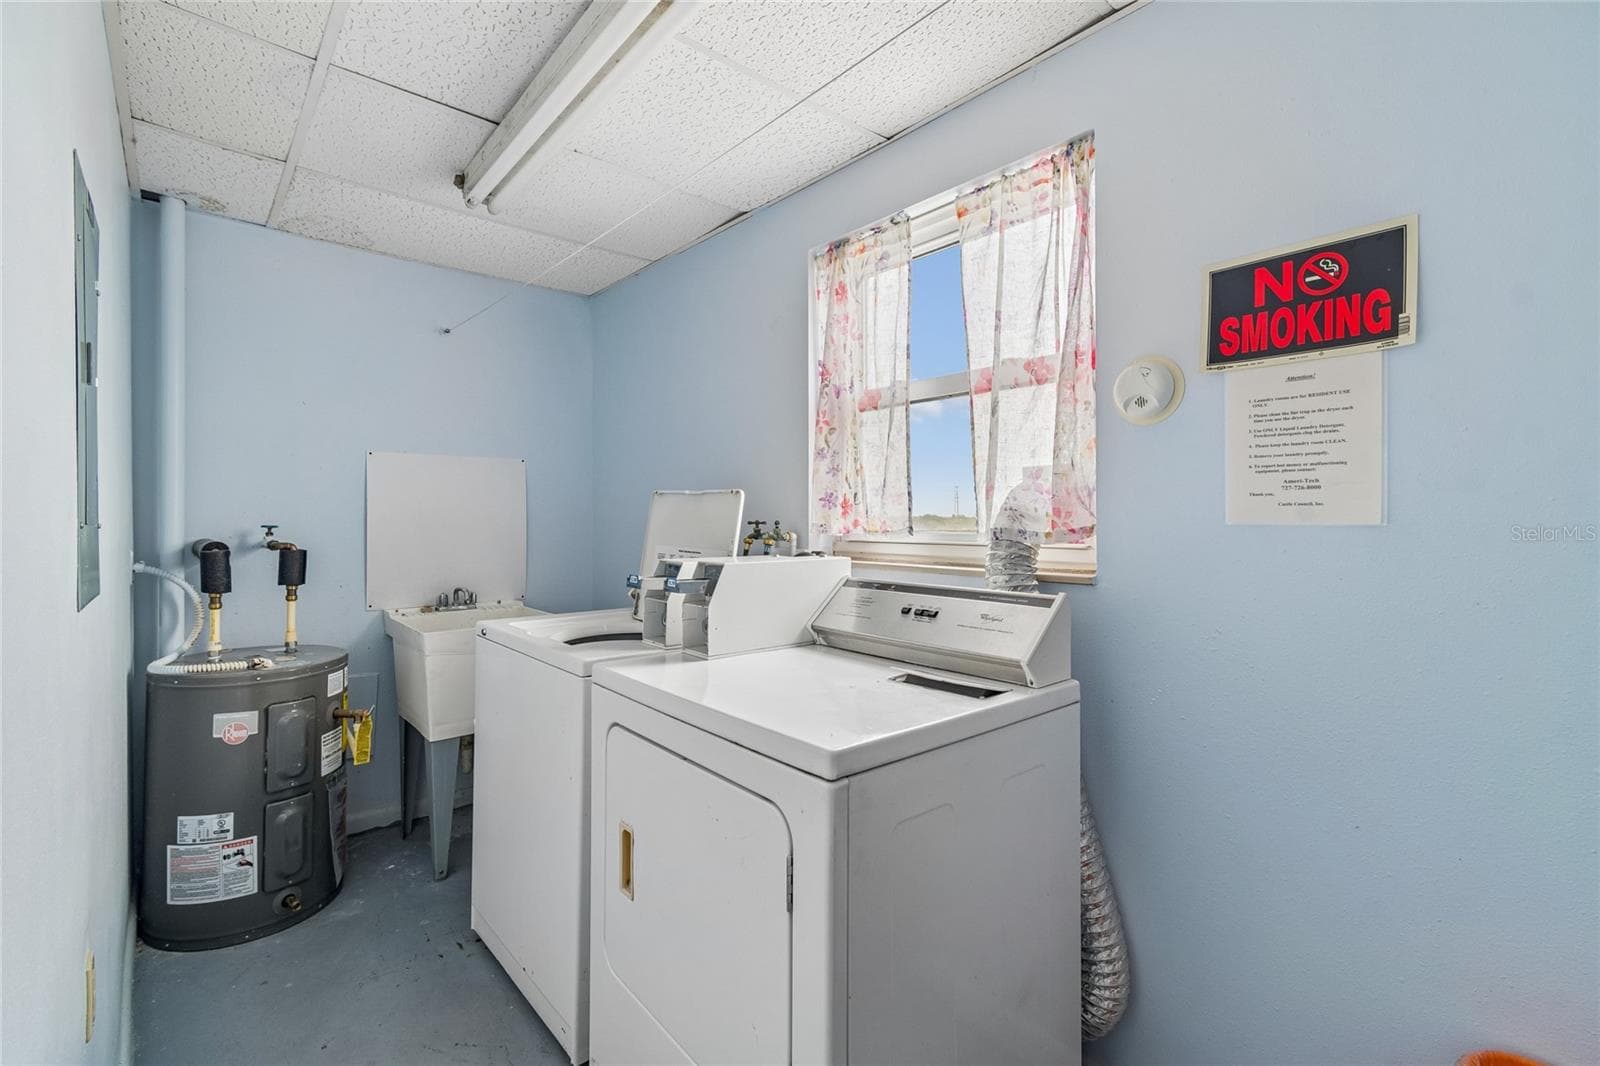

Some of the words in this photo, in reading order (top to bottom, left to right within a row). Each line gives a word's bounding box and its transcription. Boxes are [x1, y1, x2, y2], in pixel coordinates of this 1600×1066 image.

[1218, 288, 1392, 357] SMOKING
[1254, 396, 1274, 404] Laundry
[1308, 390, 1337, 398] RESIDENT
[1296, 422, 1318, 430] Laundry
[1290, 439, 1310, 447] laundry
[1261, 462, 1276, 470] report
